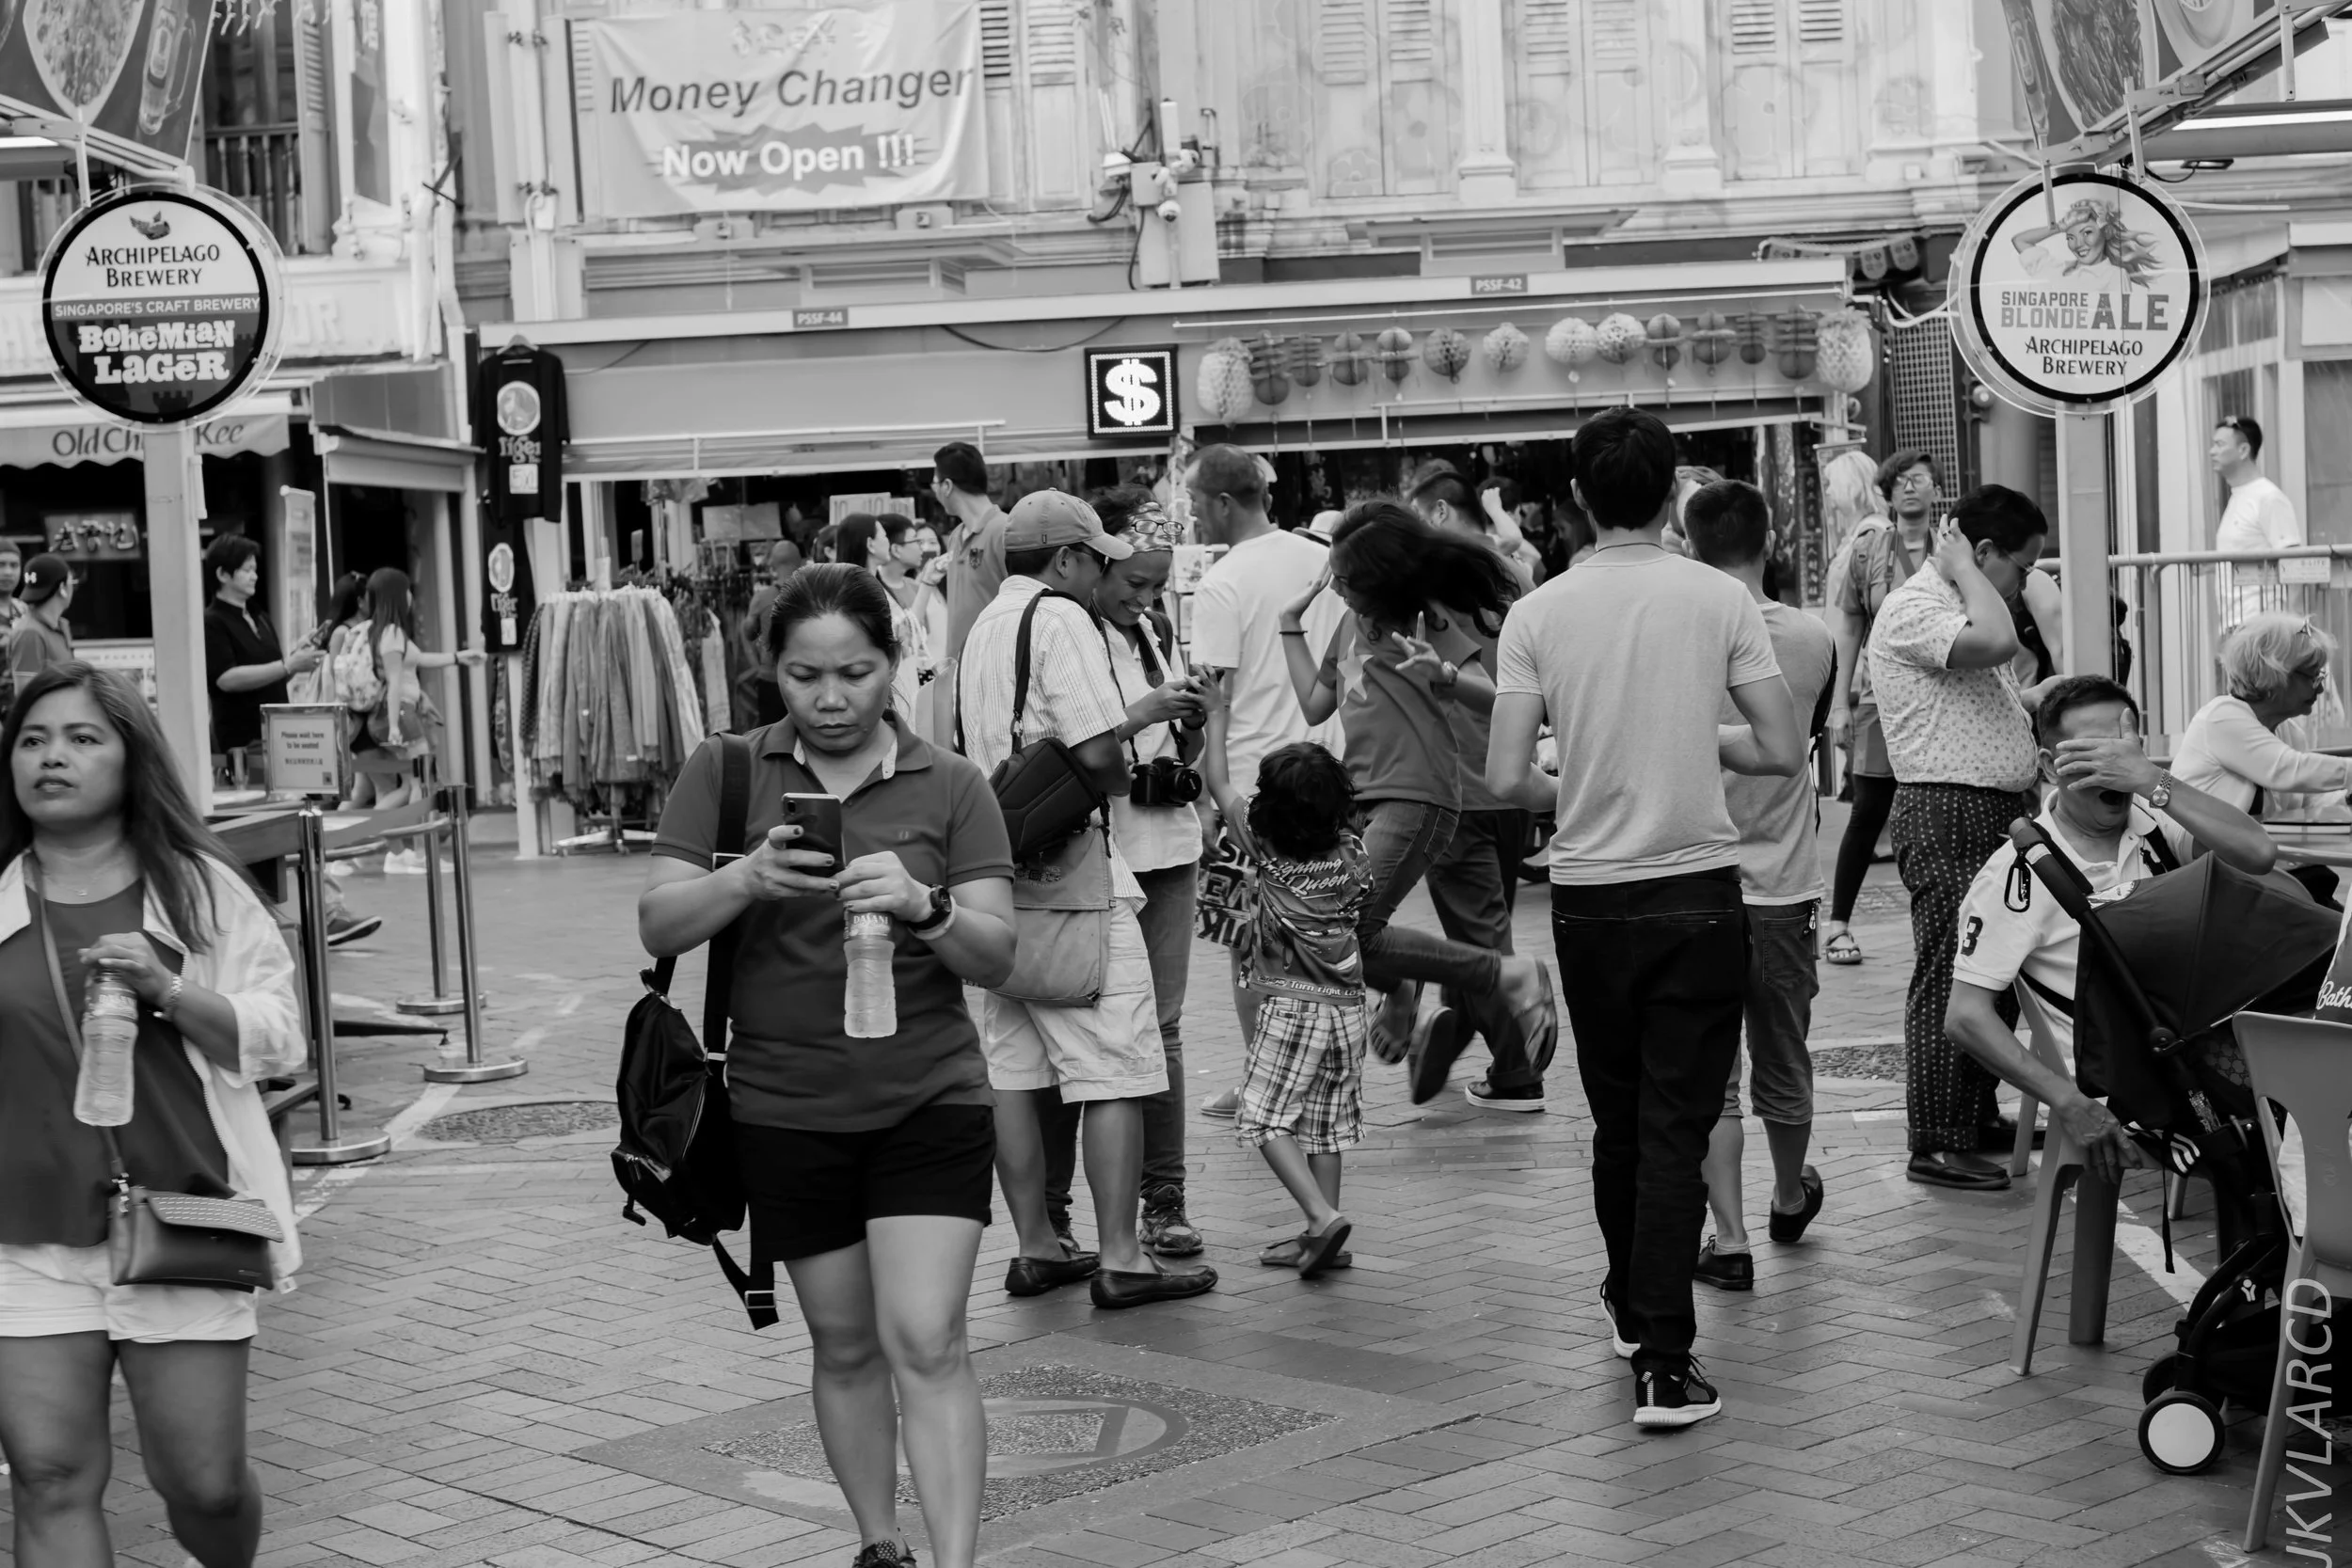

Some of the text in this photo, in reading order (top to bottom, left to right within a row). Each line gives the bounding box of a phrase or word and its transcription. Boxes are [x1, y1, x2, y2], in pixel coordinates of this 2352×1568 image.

[611, 68, 975, 119] Money Changer
[663, 145, 749, 178] Now
[759, 141, 865, 182] Open
[85, 244, 220, 267] ARCHIPELAGO
[106, 267, 202, 288] BREWERY
[55, 296, 261, 317] SINGAPORE'S CRAFT BREWERY
[2001, 291, 2089, 307] SINGAPORE
[2001, 293, 2169, 331] BLONDE ALE
[2025, 336, 2143, 356] ARCHIPELAGO
[2043, 356, 2127, 375] BREWERY
[1104, 358, 1161, 426] $
[52, 427, 99, 456] Old
[195, 422, 246, 446] Kee
[1961, 915, 1983, 957] 3
[2316, 980, 2352, 1010] Bath
